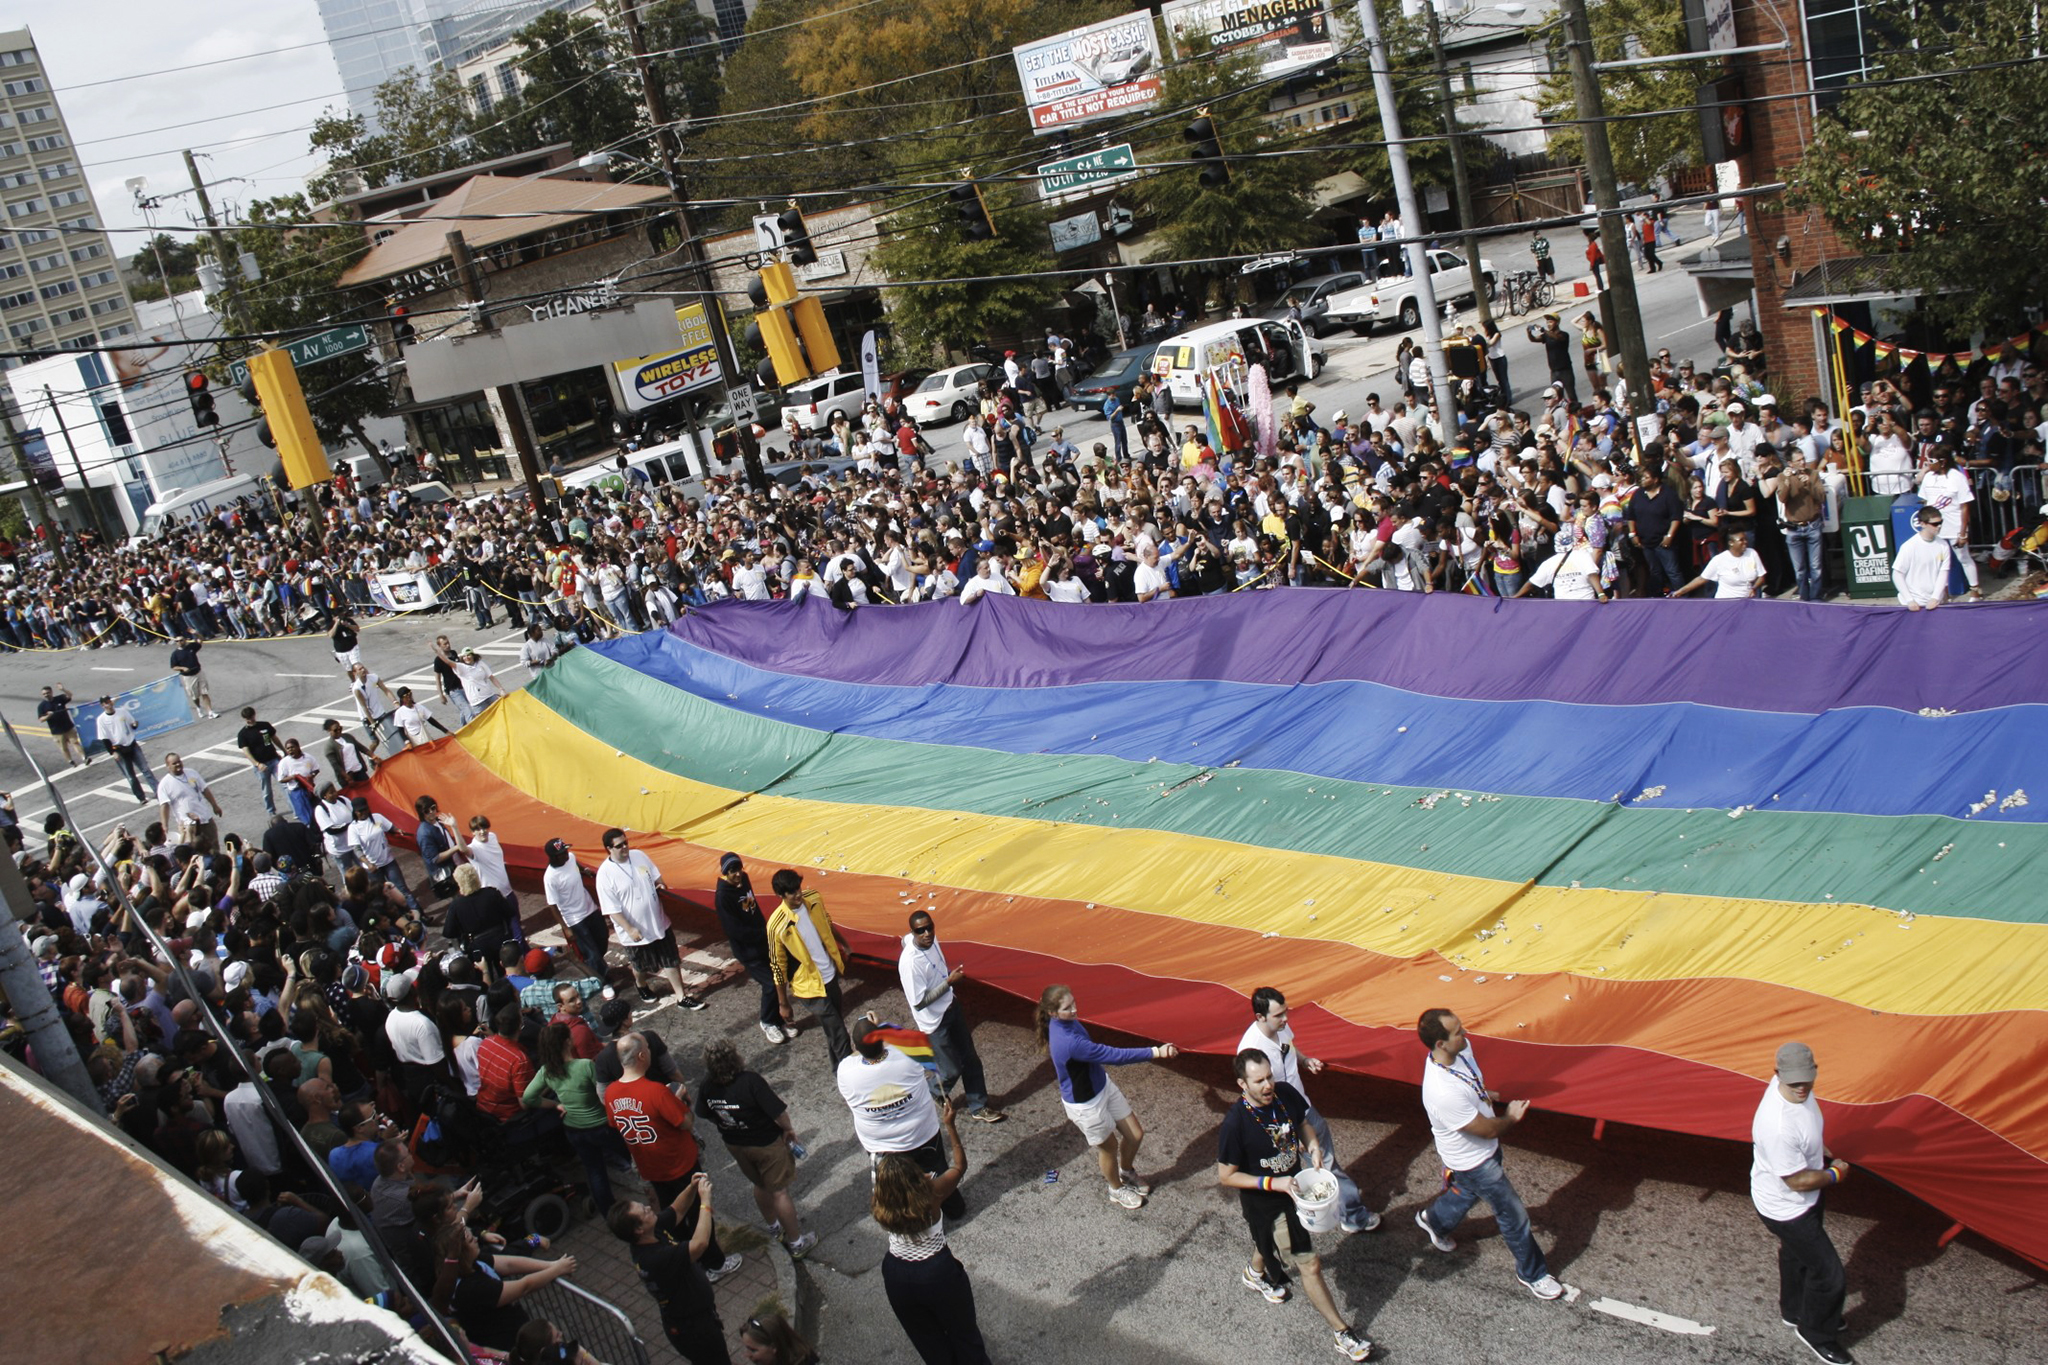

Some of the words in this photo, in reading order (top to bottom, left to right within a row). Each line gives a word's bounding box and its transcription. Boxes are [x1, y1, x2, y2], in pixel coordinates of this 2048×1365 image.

[1211, 22, 1265, 45] OCTOBER
[1267, 20, 1276, 29] 6
[1024, 54, 1045, 72] GET
[1047, 46, 1070, 65] THE
[1070, 34, 1108, 61] MOST
[1108, 25, 1146, 49] CASH!
[1036, 83, 1083, 100] 1-88-TITLEMAX
[1052, 104, 1064, 112] USE
[1065, 100, 1077, 109] THE
[1078, 94, 1099, 106] EQUITY
[1108, 88, 1125, 98] YOUR
[1126, 84, 1139, 93] CAR
[1040, 113, 1059, 124] CAR
[1060, 107, 1084, 119] TITLE
[1086, 100, 1105, 114] NOT
[1106, 88, 1157, 106] REQUIRED!
[1093, 155, 1104, 166] NE
[303, 344, 319, 360] Av
[321, 335, 332, 344] NE
[325, 341, 344, 354] 1000
[640, 348, 717, 384] WIRELESS
[655, 361, 713, 396] TOYZ
[731, 387, 748, 401] ONE
[733, 397, 751, 411] WAY
[158, 425, 196, 446] BLUE
[1849, 525, 1888, 558] CL
[1853, 558, 1888, 568] CREATIVE
[1855, 566, 1890, 577] LOAFING
[393, 585, 418, 599] PRIDE
[609, 1097, 644, 1115] LOWELL
[864, 1093, 914, 1112] VOLUNTEER
[614, 1115, 658, 1145] 25
